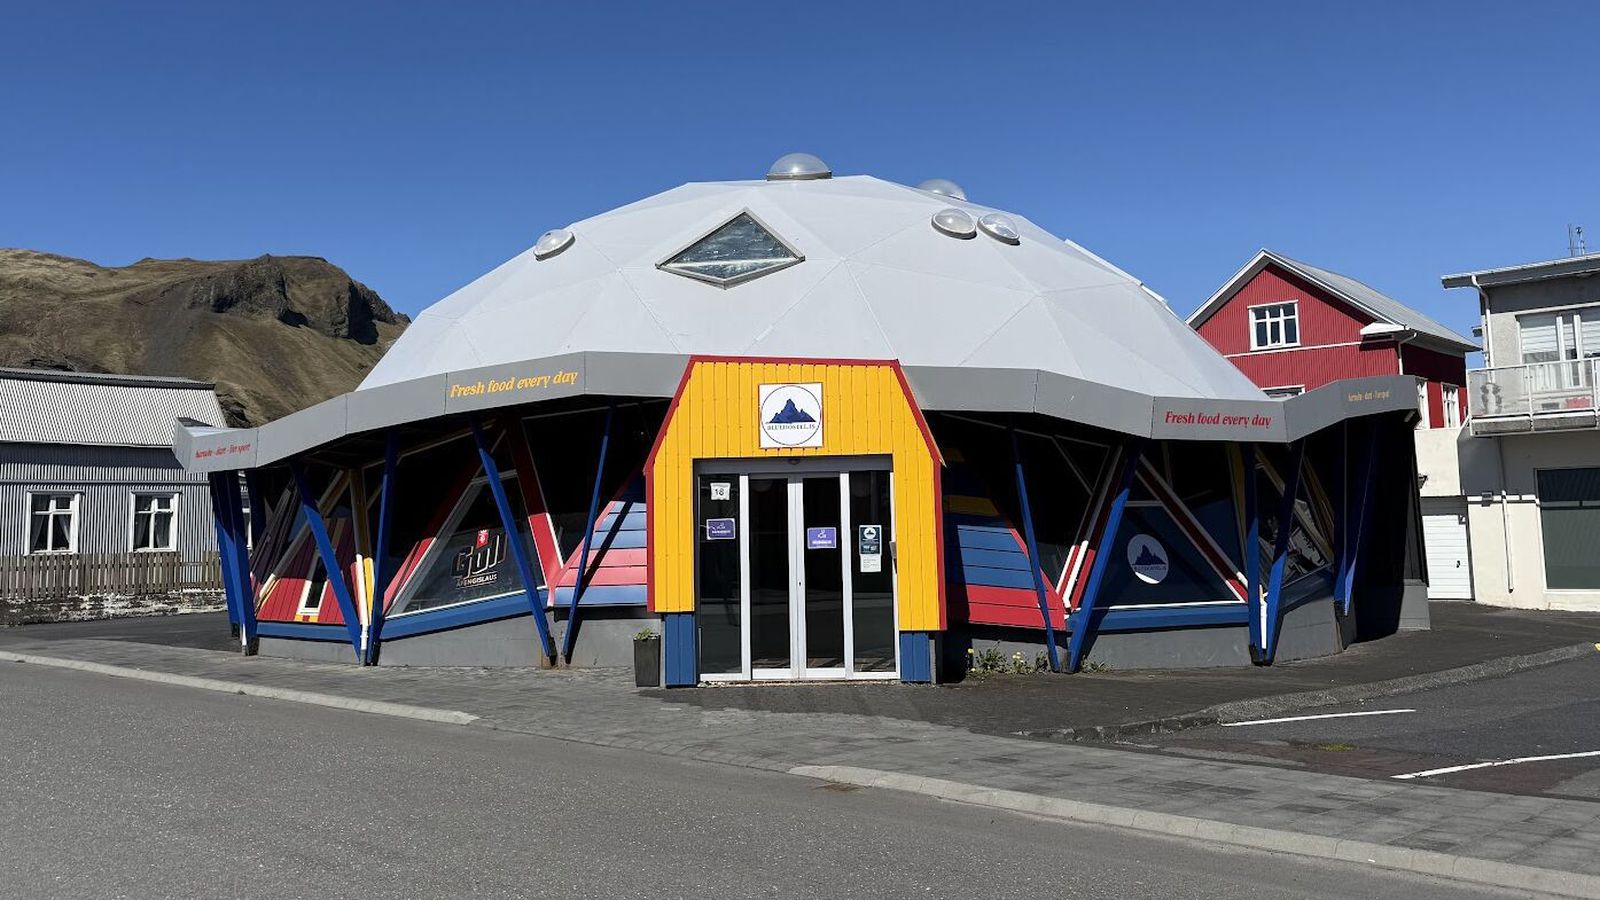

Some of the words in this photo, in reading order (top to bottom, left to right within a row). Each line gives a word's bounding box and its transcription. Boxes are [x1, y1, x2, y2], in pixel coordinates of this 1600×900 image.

[450, 382, 485, 398] Fresh
[487, 377, 516, 393] food
[517, 375, 551, 388] every
[553, 370, 578, 385] day
[1165, 411, 1195, 424] Fresh
[1197, 413, 1220, 425] food
[1222, 415, 1250, 428] every
[1251, 414, 1272, 429] day
